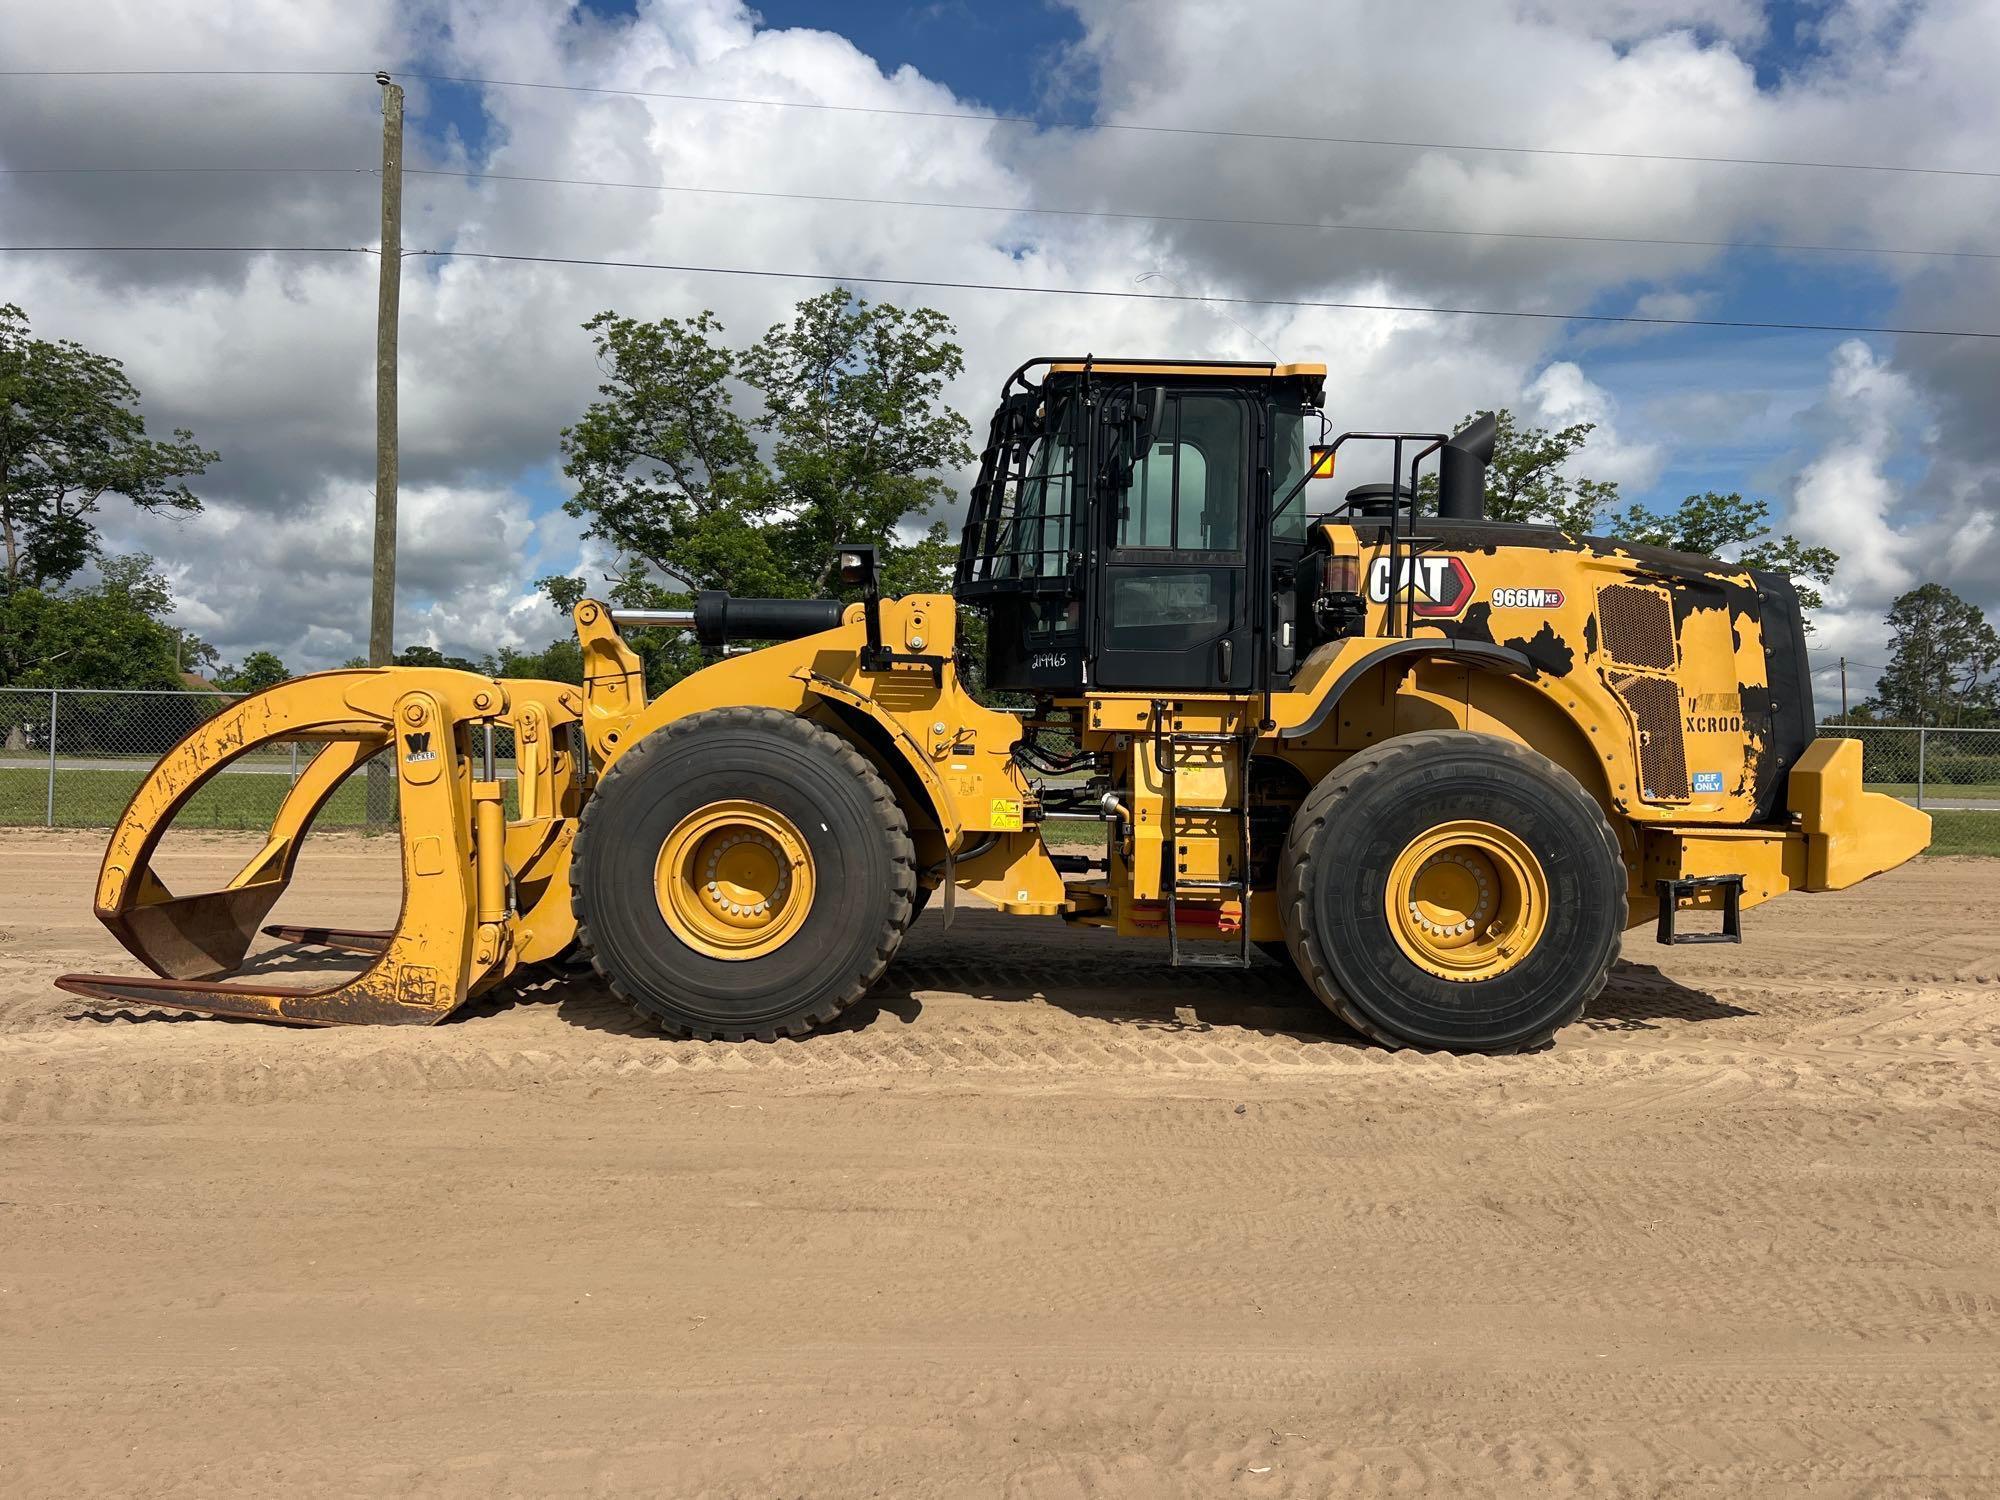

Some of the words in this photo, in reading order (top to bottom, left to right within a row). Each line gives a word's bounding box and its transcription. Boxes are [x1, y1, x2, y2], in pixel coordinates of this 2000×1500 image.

[1370, 557, 1449, 603] CAT
[1031, 652, 1067, 669] 219965
[1698, 773, 1717, 782] DEF
[1695, 782, 1720, 791] ONLY
